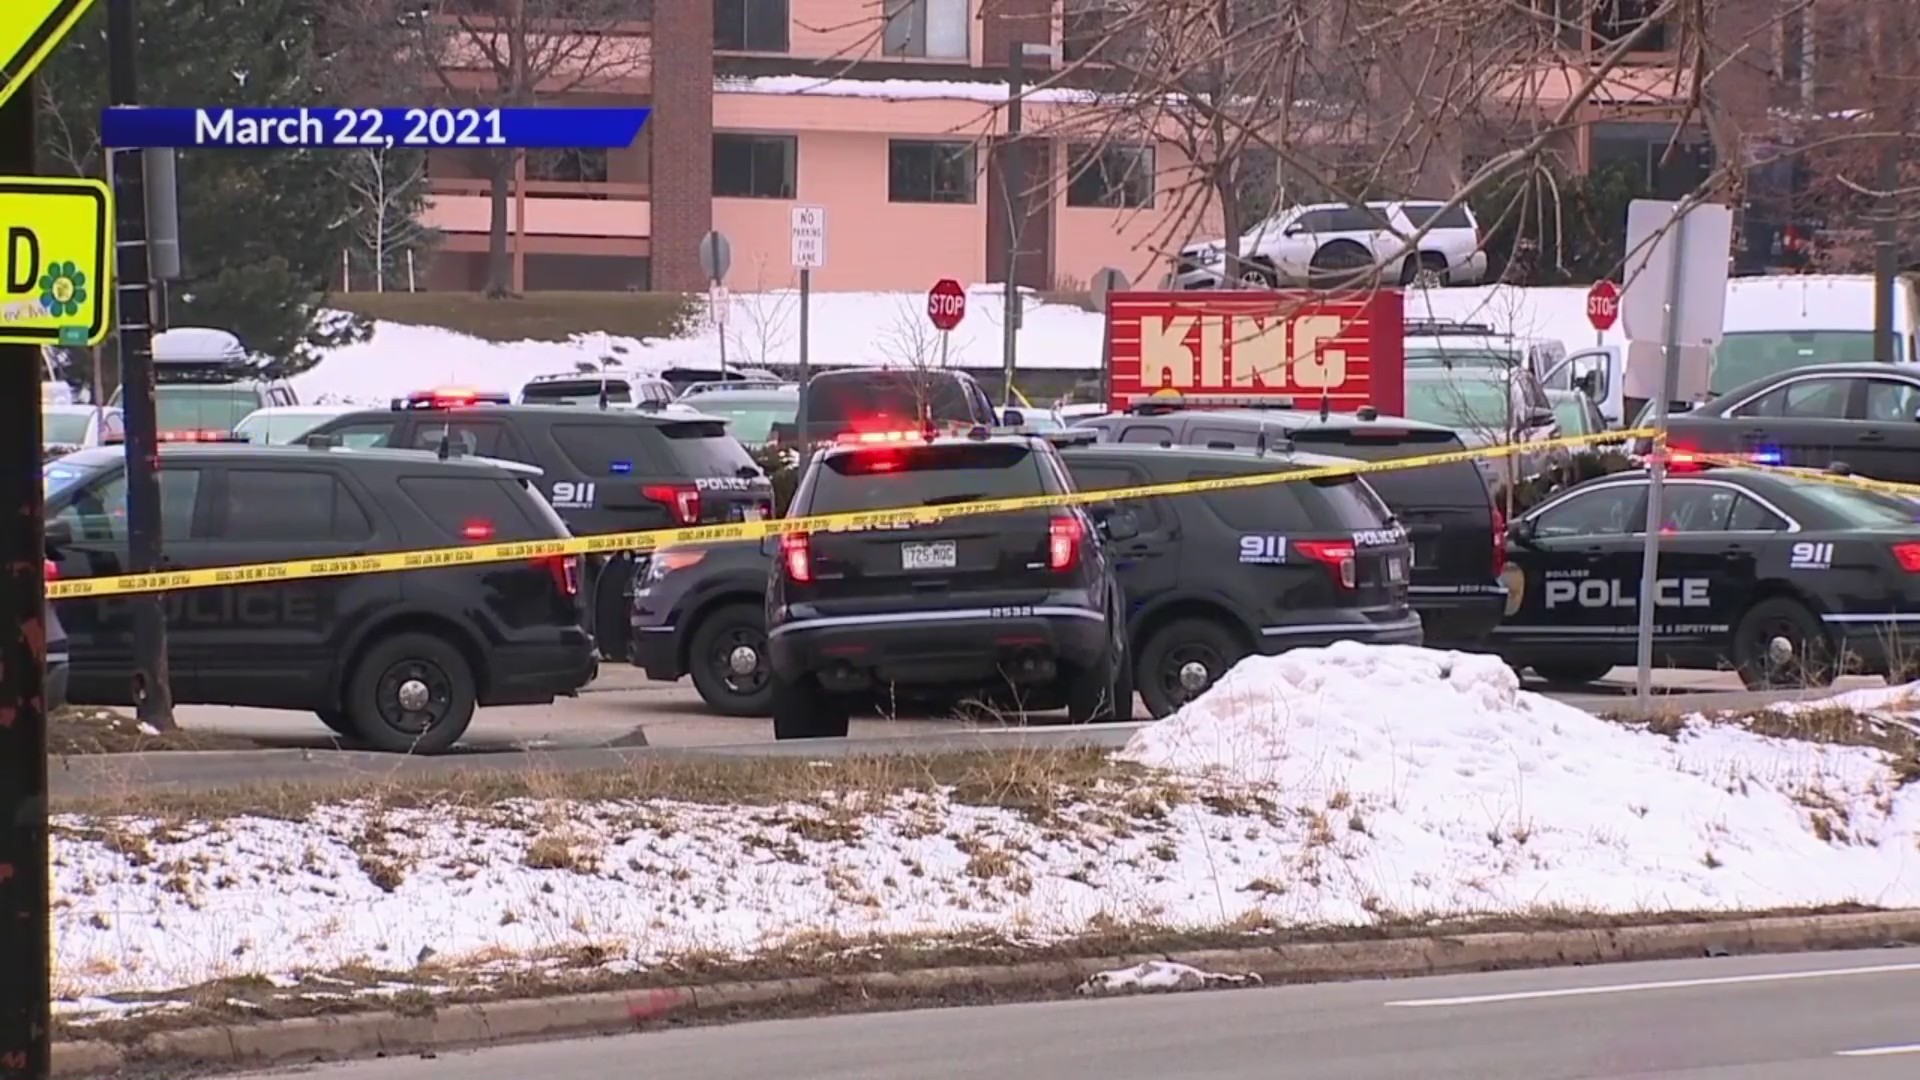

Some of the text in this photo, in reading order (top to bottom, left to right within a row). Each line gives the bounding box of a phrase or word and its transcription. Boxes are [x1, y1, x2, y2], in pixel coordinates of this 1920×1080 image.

[800, 212, 814, 225] NO
[7, 226, 40, 294] D
[930, 293, 964, 316] STOP
[1140, 315, 1346, 388] KING
[553, 482, 595, 502] 911
[695, 477, 749, 491] POLICE
[1241, 536, 1286, 556] 911
[1353, 529, 1398, 546] POLICE
[1792, 543, 1833, 563] 911
[1545, 578, 1710, 609] POLCE
